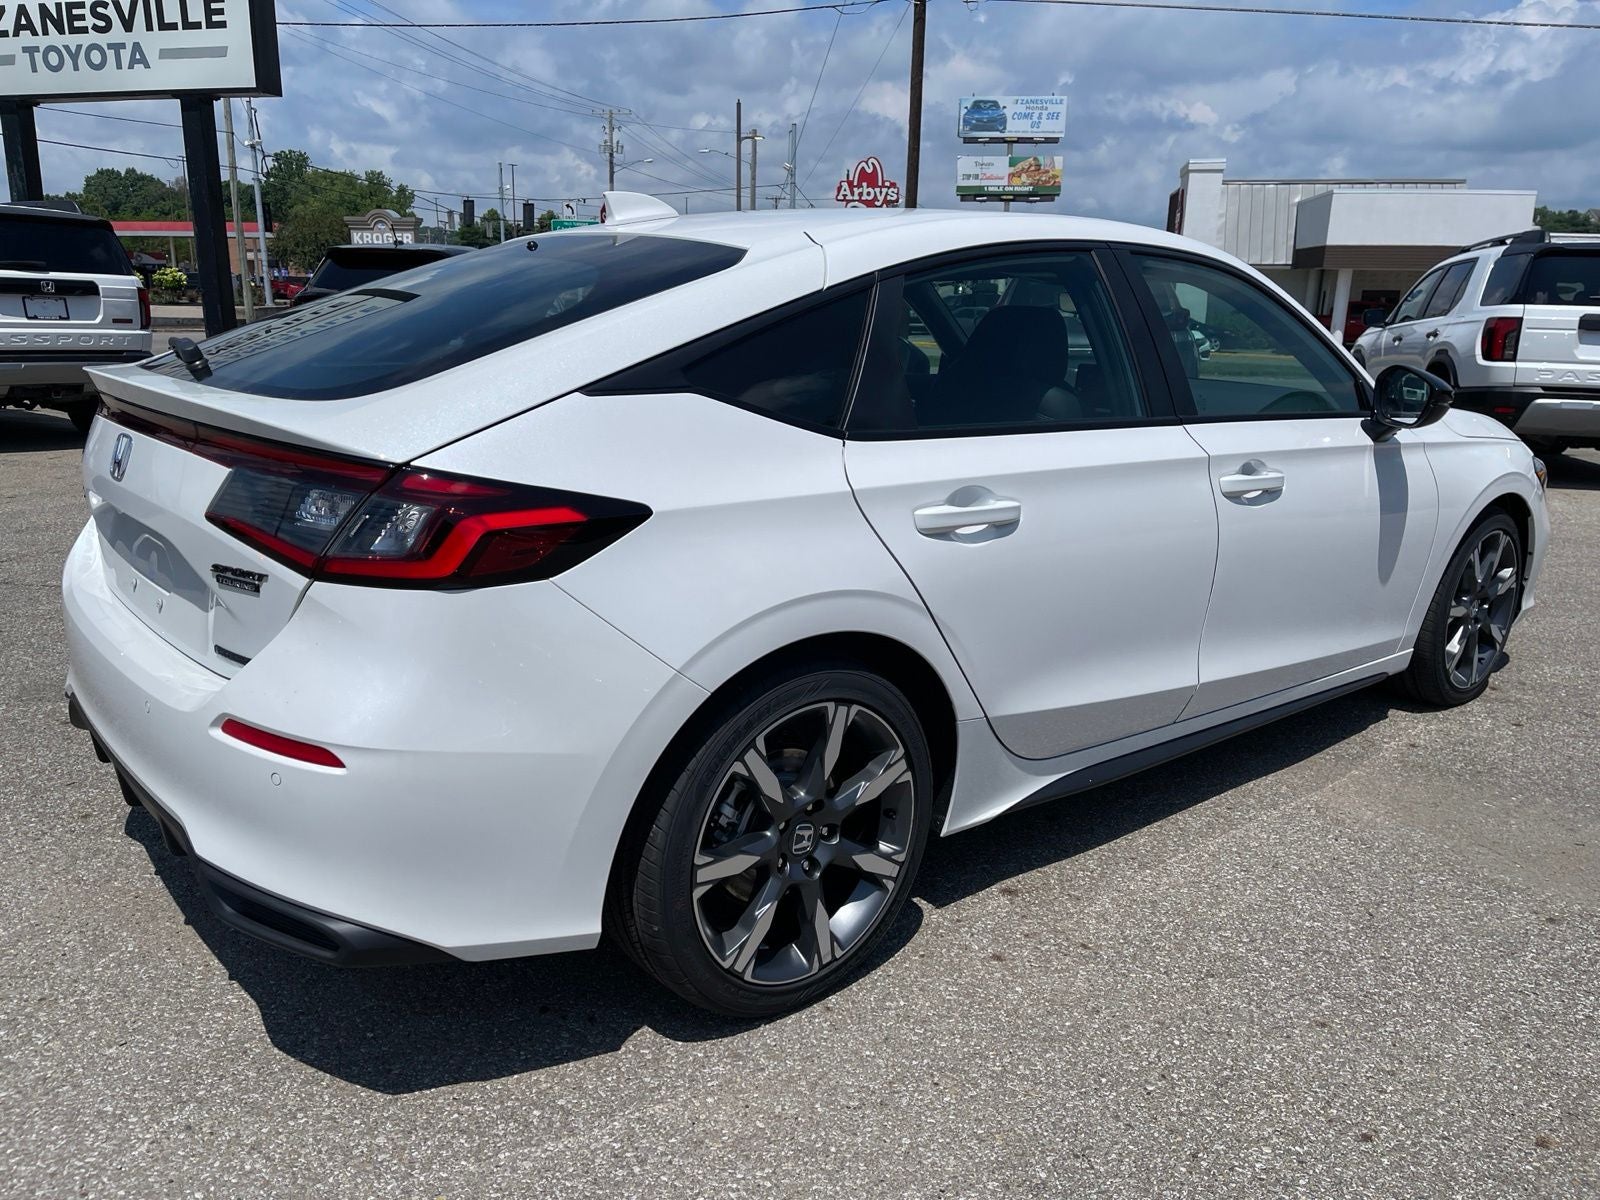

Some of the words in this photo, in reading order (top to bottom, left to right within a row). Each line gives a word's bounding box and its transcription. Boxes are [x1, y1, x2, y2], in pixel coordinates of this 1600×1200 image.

[21, 41, 151, 73] TOYOTA
[1012, 112, 1034, 120] COME
[1037, 112, 1043, 120] &
[1046, 112, 1060, 120] SEE
[837, 181, 898, 206] Arby's
[0, 334, 132, 346] SSPORT
[210, 564, 269, 581] SPORT
[217, 576, 257, 591] TOURING
